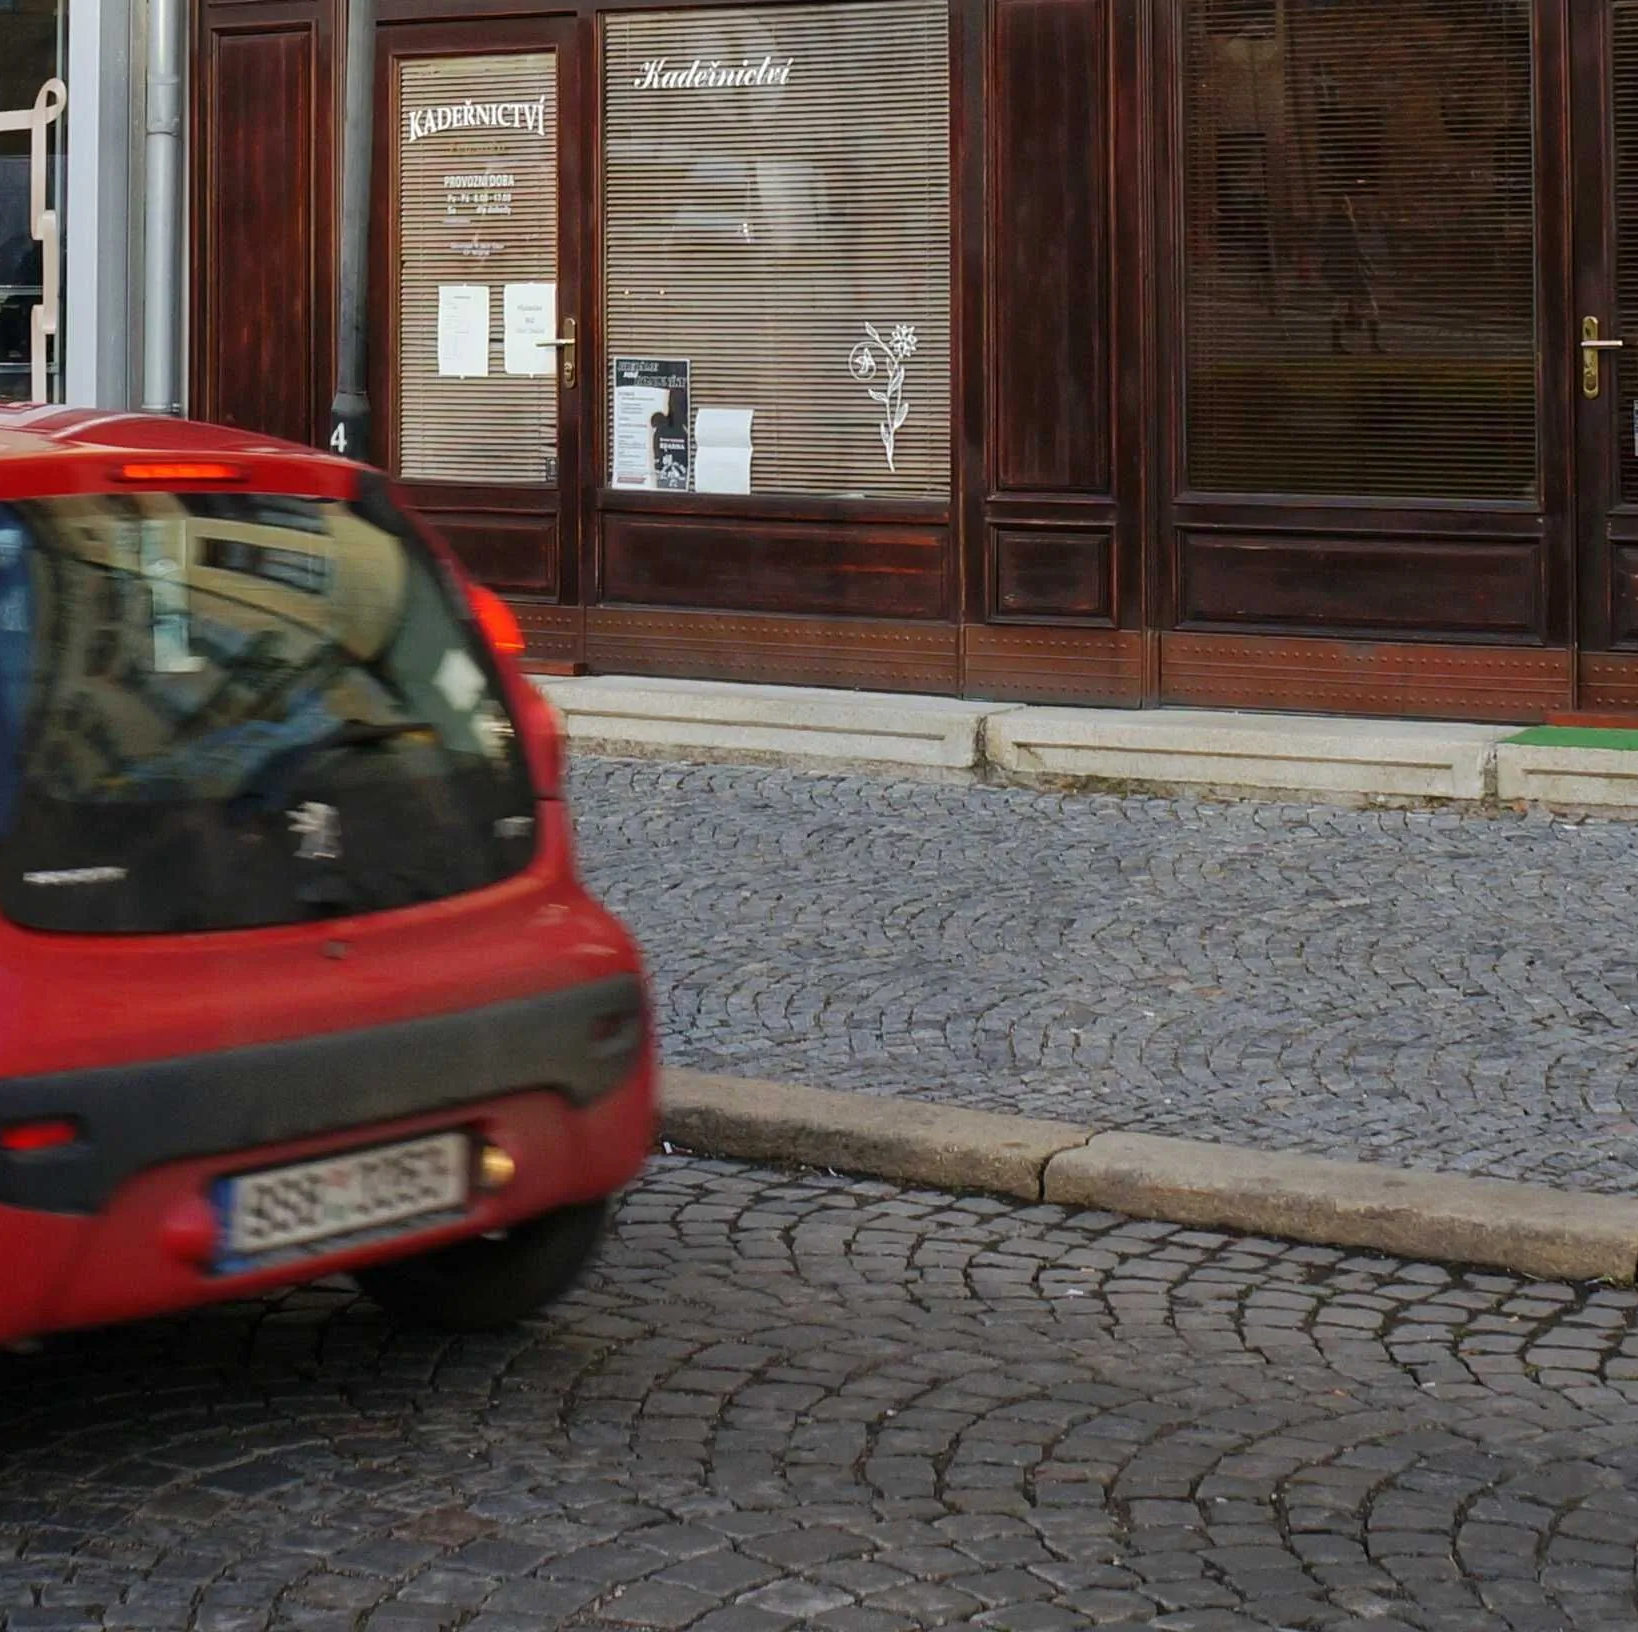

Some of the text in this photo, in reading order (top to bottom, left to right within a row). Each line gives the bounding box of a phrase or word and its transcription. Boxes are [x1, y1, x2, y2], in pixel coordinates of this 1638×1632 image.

[632, 56, 795, 91] Kadeřnictví
[408, 95, 546, 143] KADEŘNICTVÍ
[330, 421, 348, 453] 4
